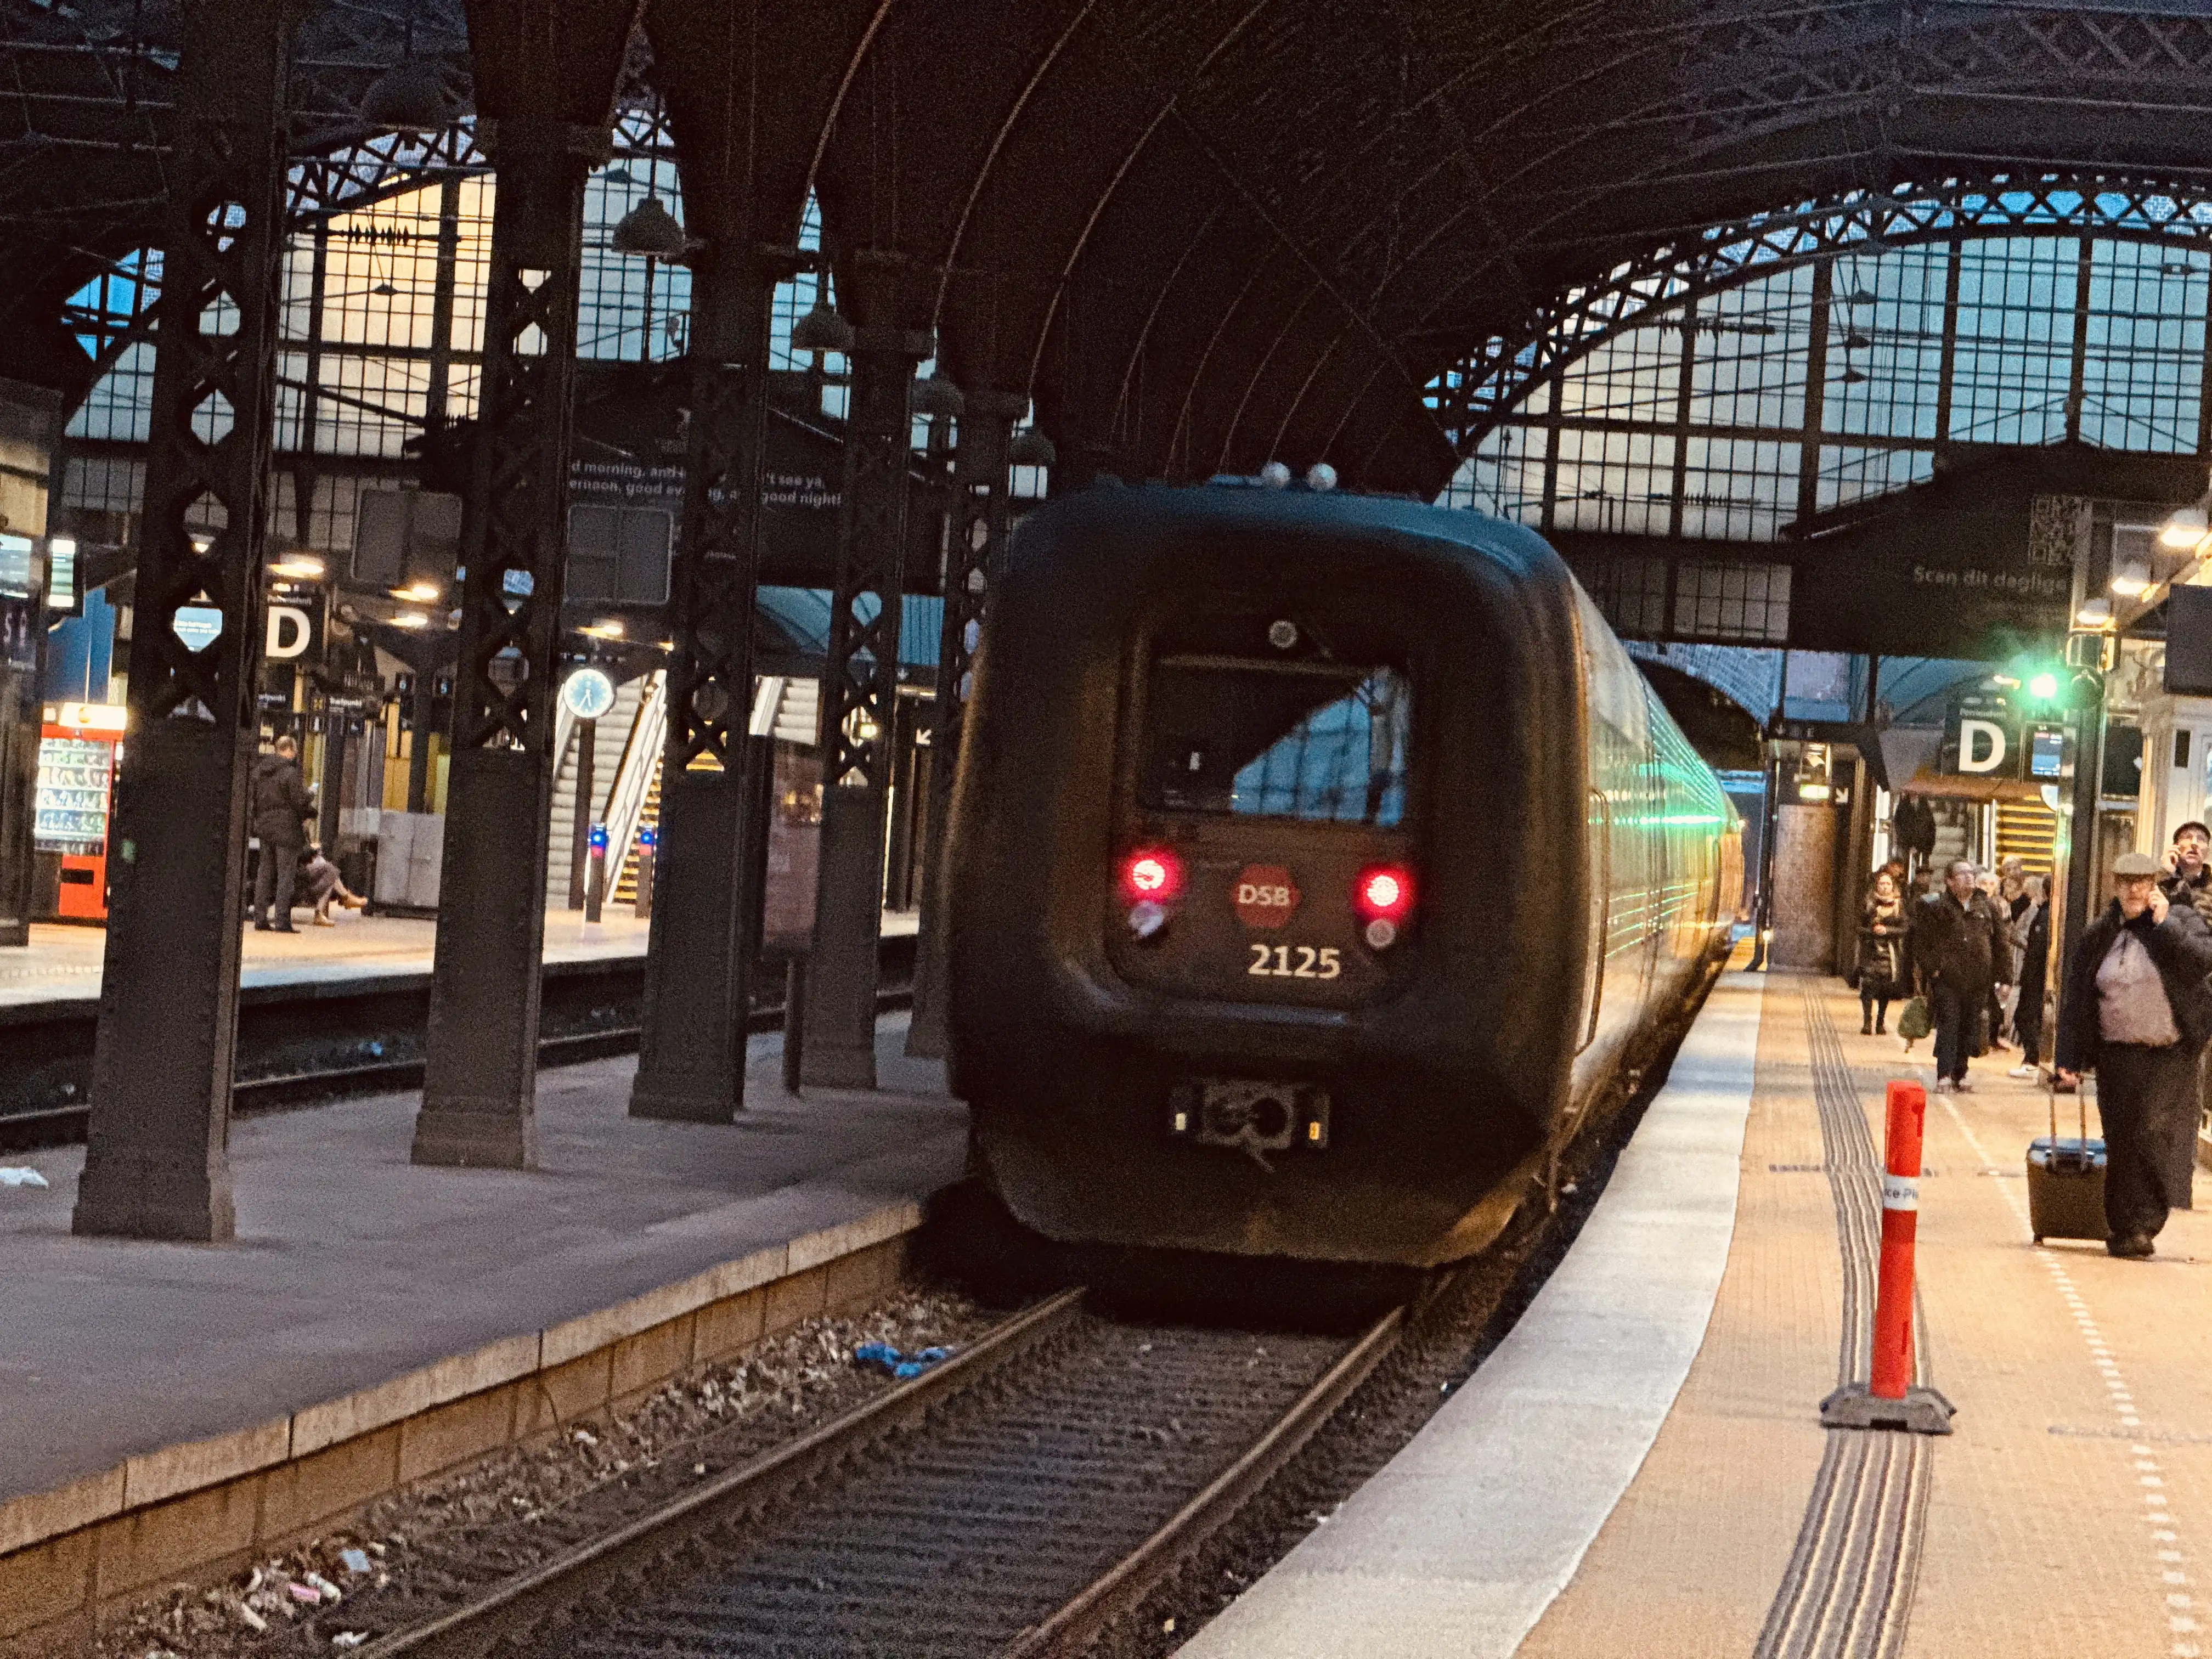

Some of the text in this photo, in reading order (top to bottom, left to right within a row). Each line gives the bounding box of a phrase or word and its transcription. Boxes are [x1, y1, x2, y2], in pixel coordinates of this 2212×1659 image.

[584, 462, 646, 479] morning,
[778, 475, 803, 486] see
[626, 482, 663, 497] good
[1914, 566, 1957, 587] Scan
[1963, 568, 1988, 587] dit
[266, 606, 311, 658] D
[1959, 719, 2006, 772] D
[1238, 884, 1290, 906] DSB
[1248, 944, 1341, 979] 2125
